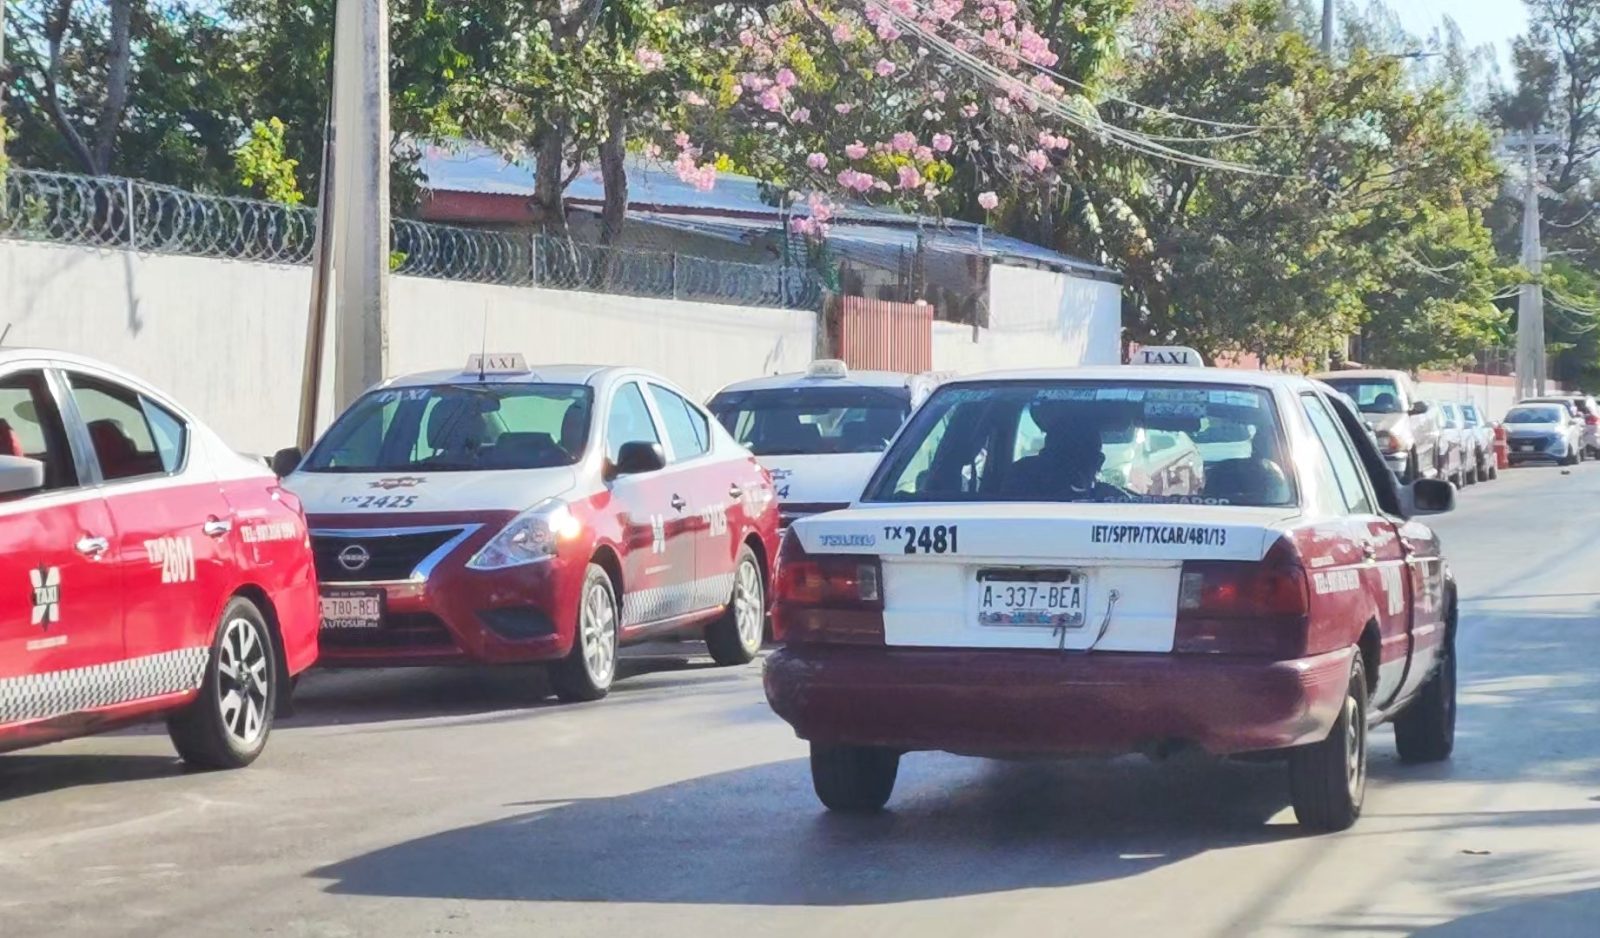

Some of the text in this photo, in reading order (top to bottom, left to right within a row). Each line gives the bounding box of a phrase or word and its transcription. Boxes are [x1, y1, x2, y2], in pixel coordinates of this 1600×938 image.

[474, 357, 515, 369] TAXI
[1141, 351, 1187, 364] TAXI
[376, 389, 431, 403] TAXI
[1091, 525, 1226, 546] IET/SPTP/TXCAR/481/13
[35, 587, 58, 606] TAXI
[983, 585, 1080, 608] A-337-BEA
